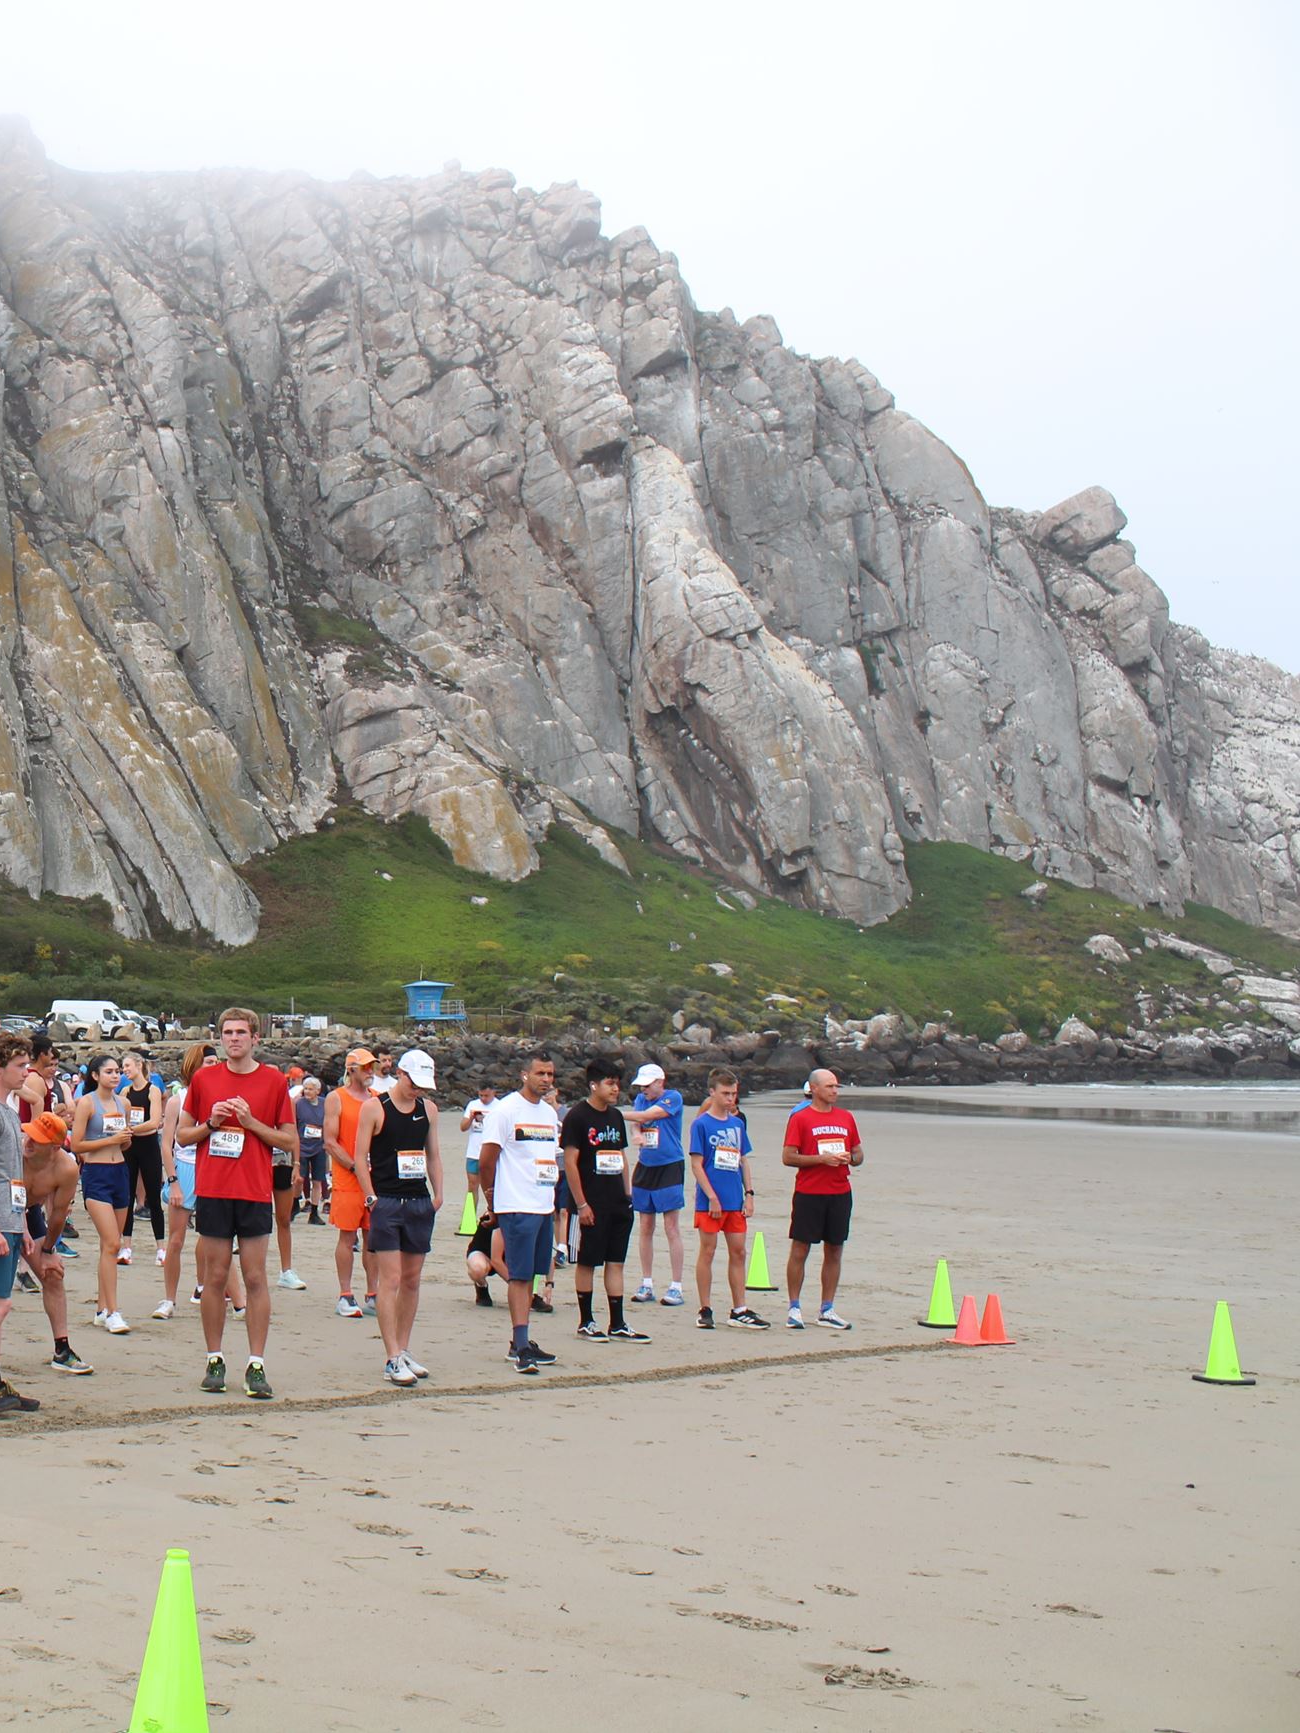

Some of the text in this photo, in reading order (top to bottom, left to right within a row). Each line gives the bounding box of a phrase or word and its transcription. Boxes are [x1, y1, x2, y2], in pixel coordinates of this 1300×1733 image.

[812, 1126, 847, 1136] BUCHANAN
[221, 1133, 240, 1144] 489
[411, 1157, 424, 1165] 265
